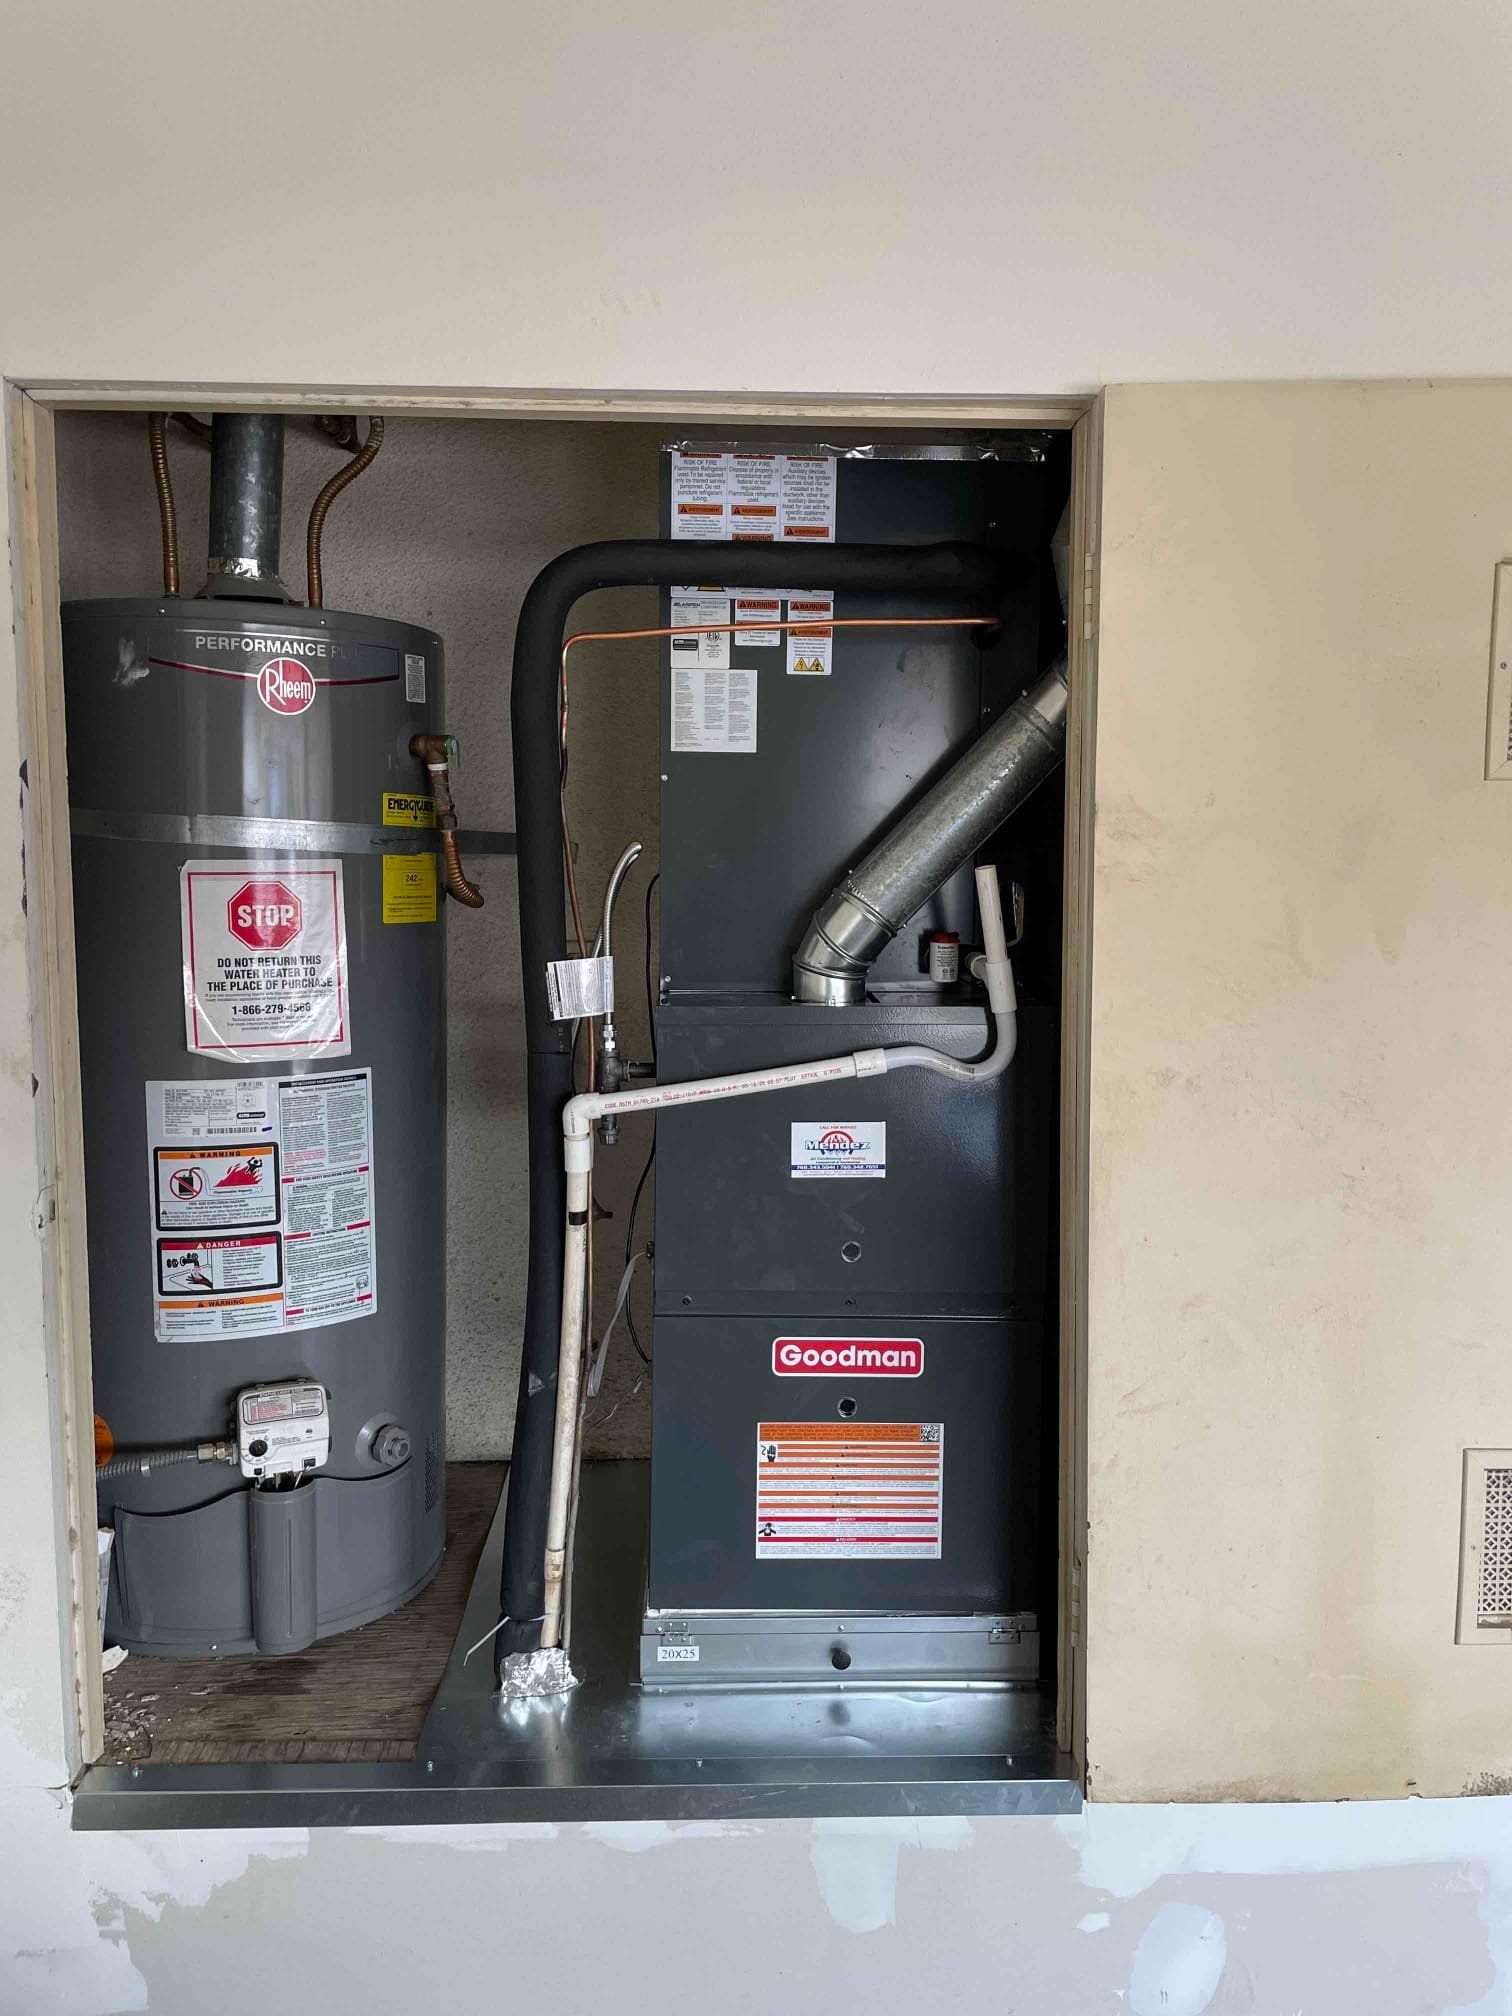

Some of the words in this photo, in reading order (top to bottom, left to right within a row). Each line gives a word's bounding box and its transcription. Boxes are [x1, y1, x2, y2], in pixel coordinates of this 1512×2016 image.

[746, 601, 777, 609] WARNING
[195, 636, 327, 657] PERFORMANCE
[264, 659, 312, 706] Rheem
[237, 904, 294, 928] STOP
[217, 958, 231, 968] DO
[234, 957, 254, 968] NOT
[257, 956, 297, 967] RETURN
[300, 955, 322, 965] THIS
[224, 969, 259, 979] WATER
[262, 967, 300, 978] HEATER
[303, 966, 316, 976] TO
[207, 981, 226, 991] THE
[230, 980, 262, 991] PLACE
[265, 979, 279, 990] OF
[281, 977, 333, 989] PURCHASE
[805, 1140, 870, 1150] Mendez
[199, 1150, 241, 1159] WARNING
[205, 1240, 241, 1249] DANGER
[208, 1298, 245, 1307] WARNING
[780, 1344, 916, 1367] Goodman
[661, 1649, 696, 1659] 20X25
